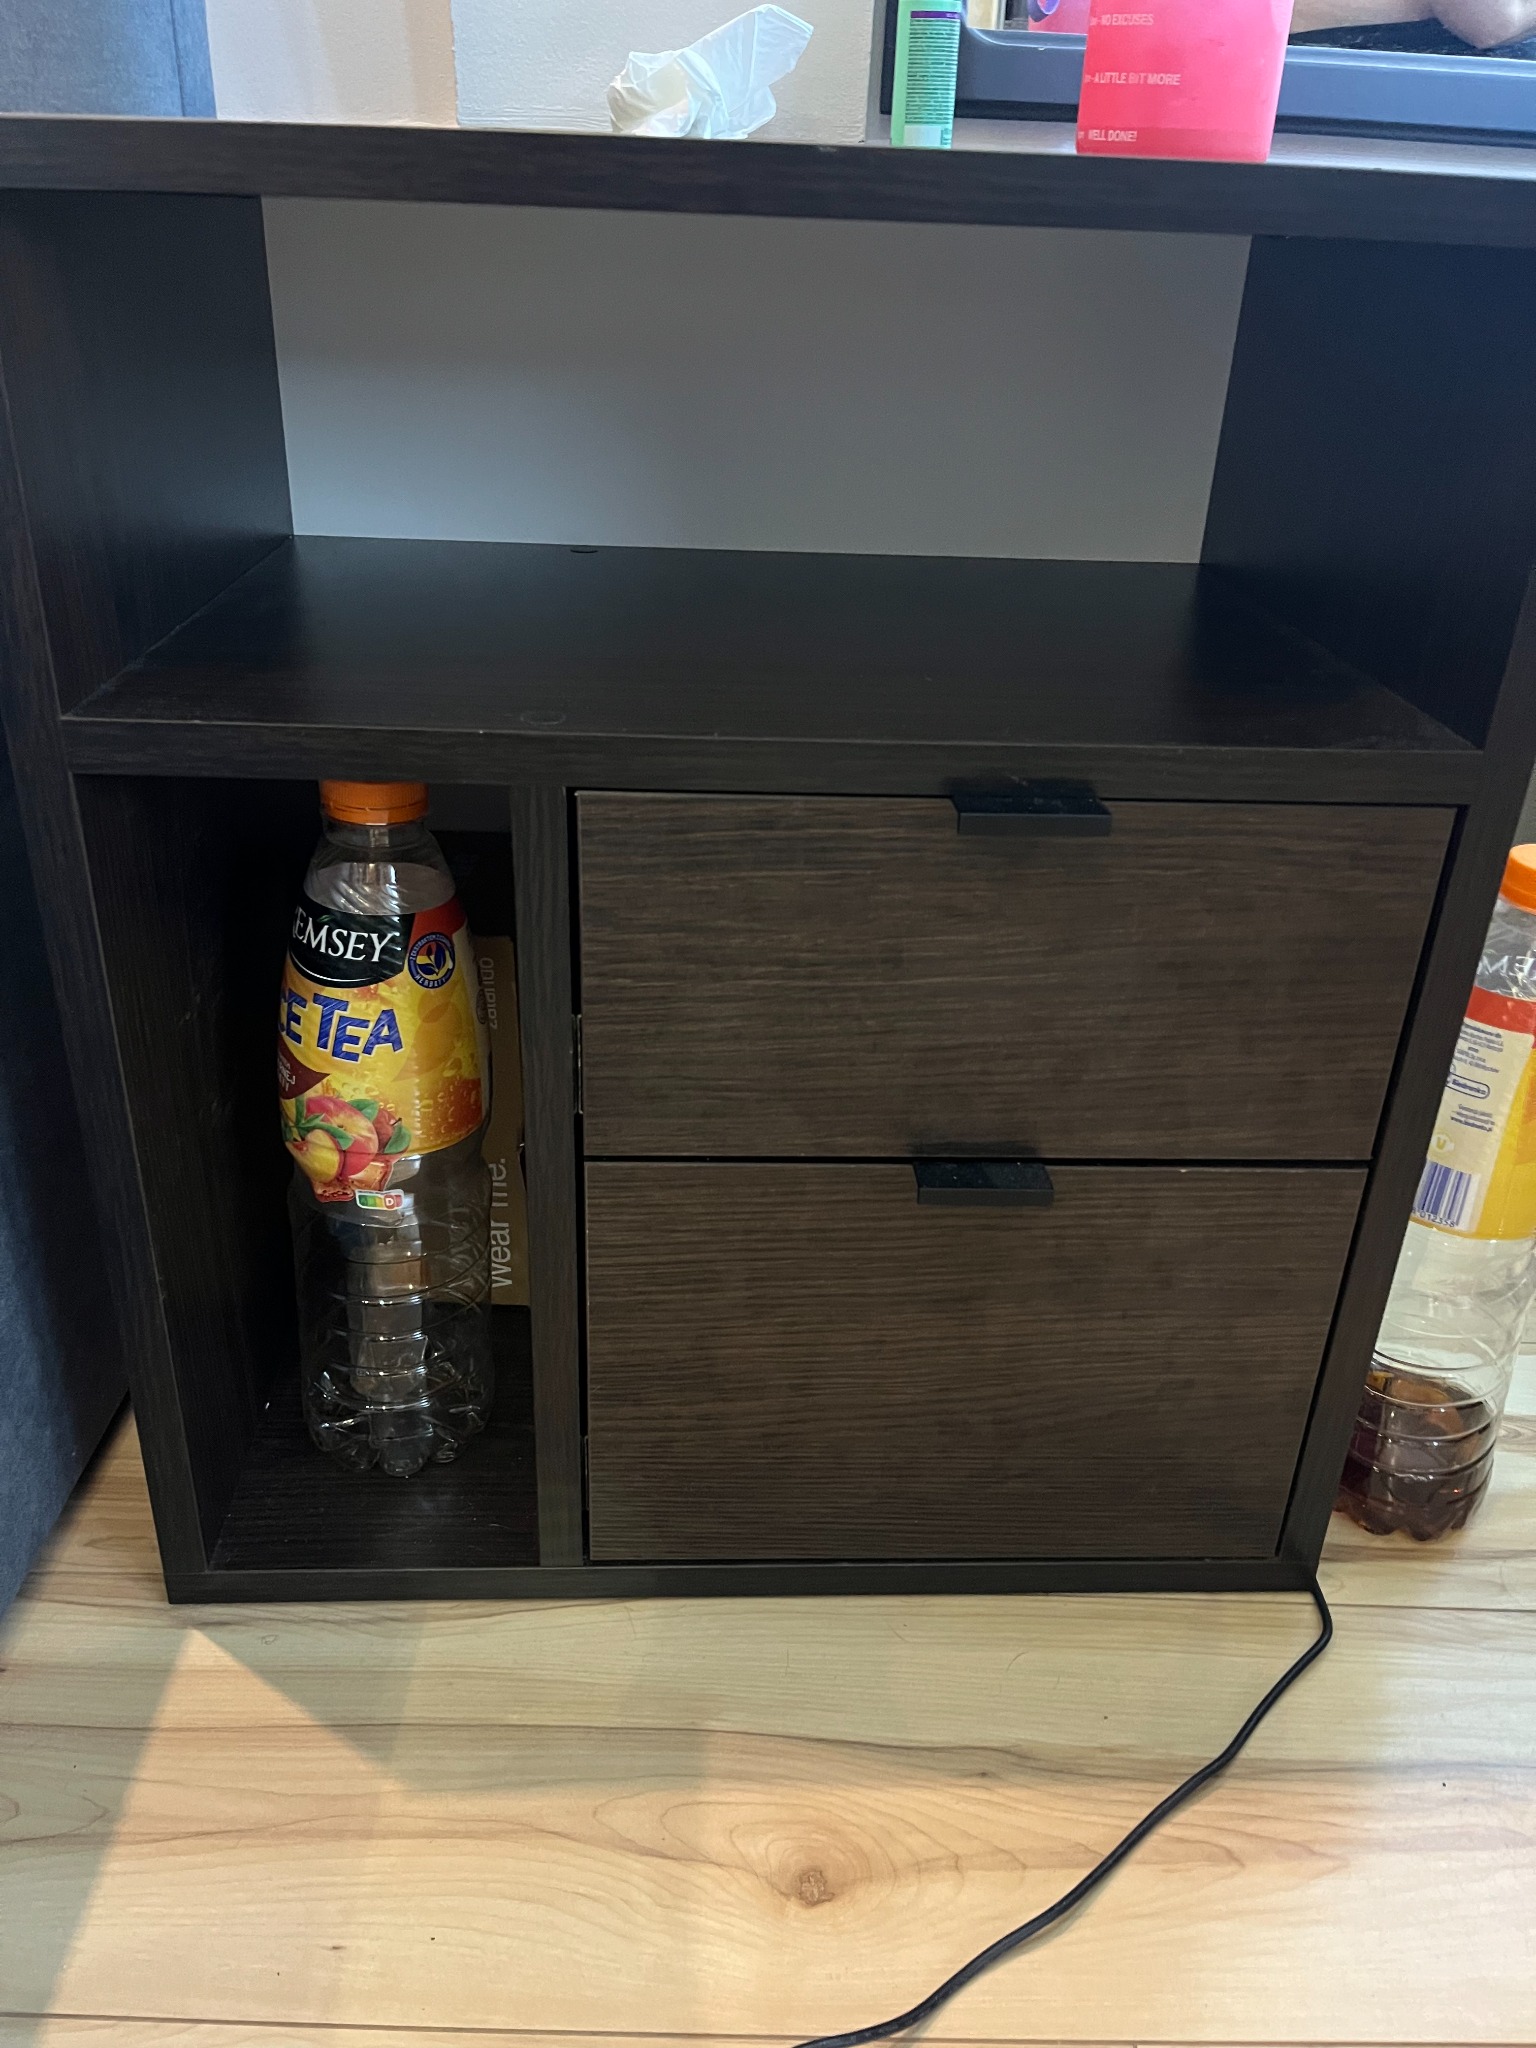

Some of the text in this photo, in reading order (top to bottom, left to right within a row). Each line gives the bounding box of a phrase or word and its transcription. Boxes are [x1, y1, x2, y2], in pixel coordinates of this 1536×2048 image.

[1147, 73, 1181, 85] MORE
[292, 907, 399, 962] EMSEY
[312, 992, 404, 1062] TEA
